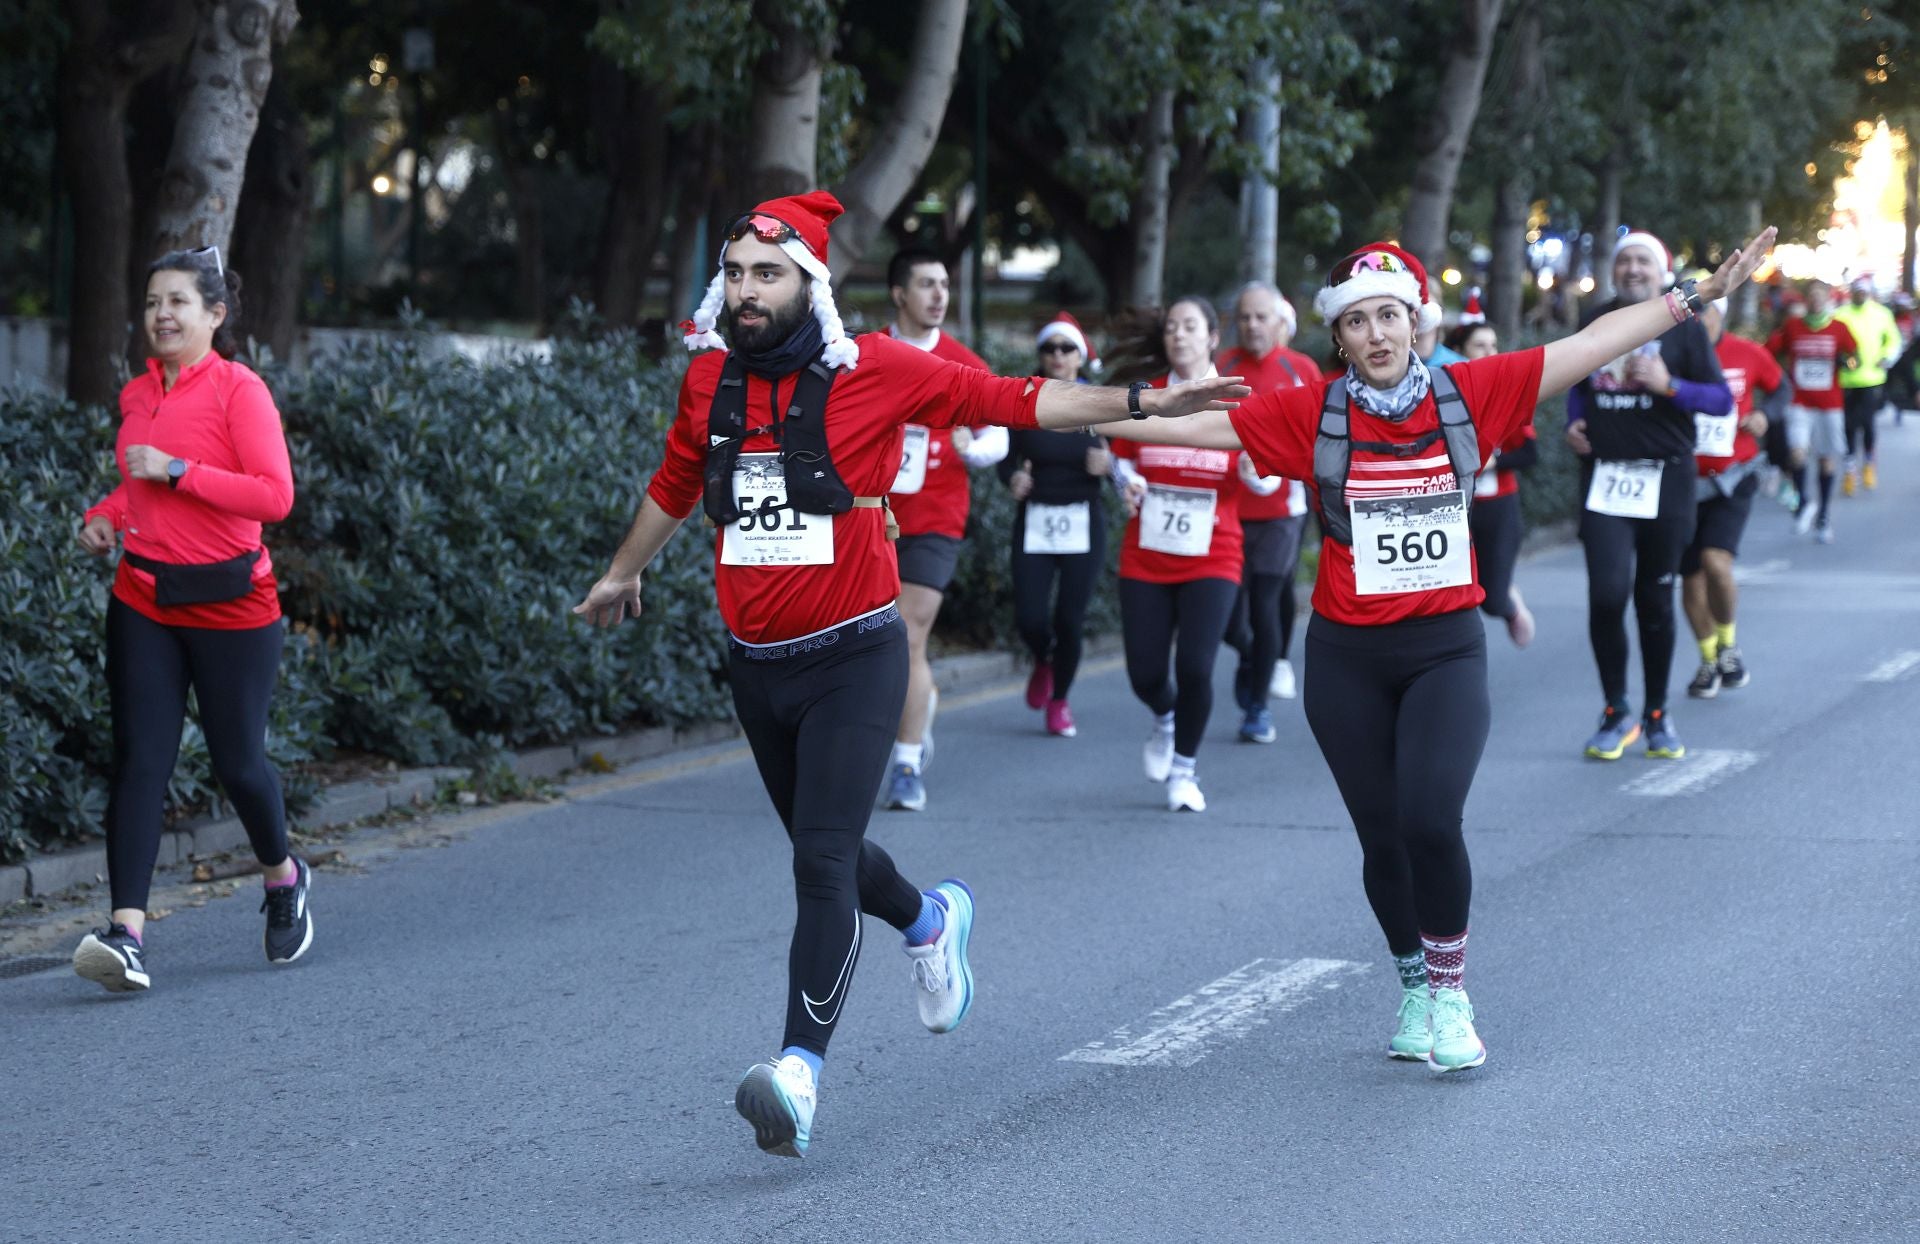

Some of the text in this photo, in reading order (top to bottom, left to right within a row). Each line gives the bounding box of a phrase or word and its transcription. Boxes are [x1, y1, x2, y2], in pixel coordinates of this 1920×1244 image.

[1605, 475, 1645, 498] 702
[738, 496, 808, 532] 561
[1161, 511, 1191, 534] 76
[1377, 529, 1448, 565] 560
[858, 606, 899, 634] NIKE
[745, 631, 839, 660] NIKE PRO
